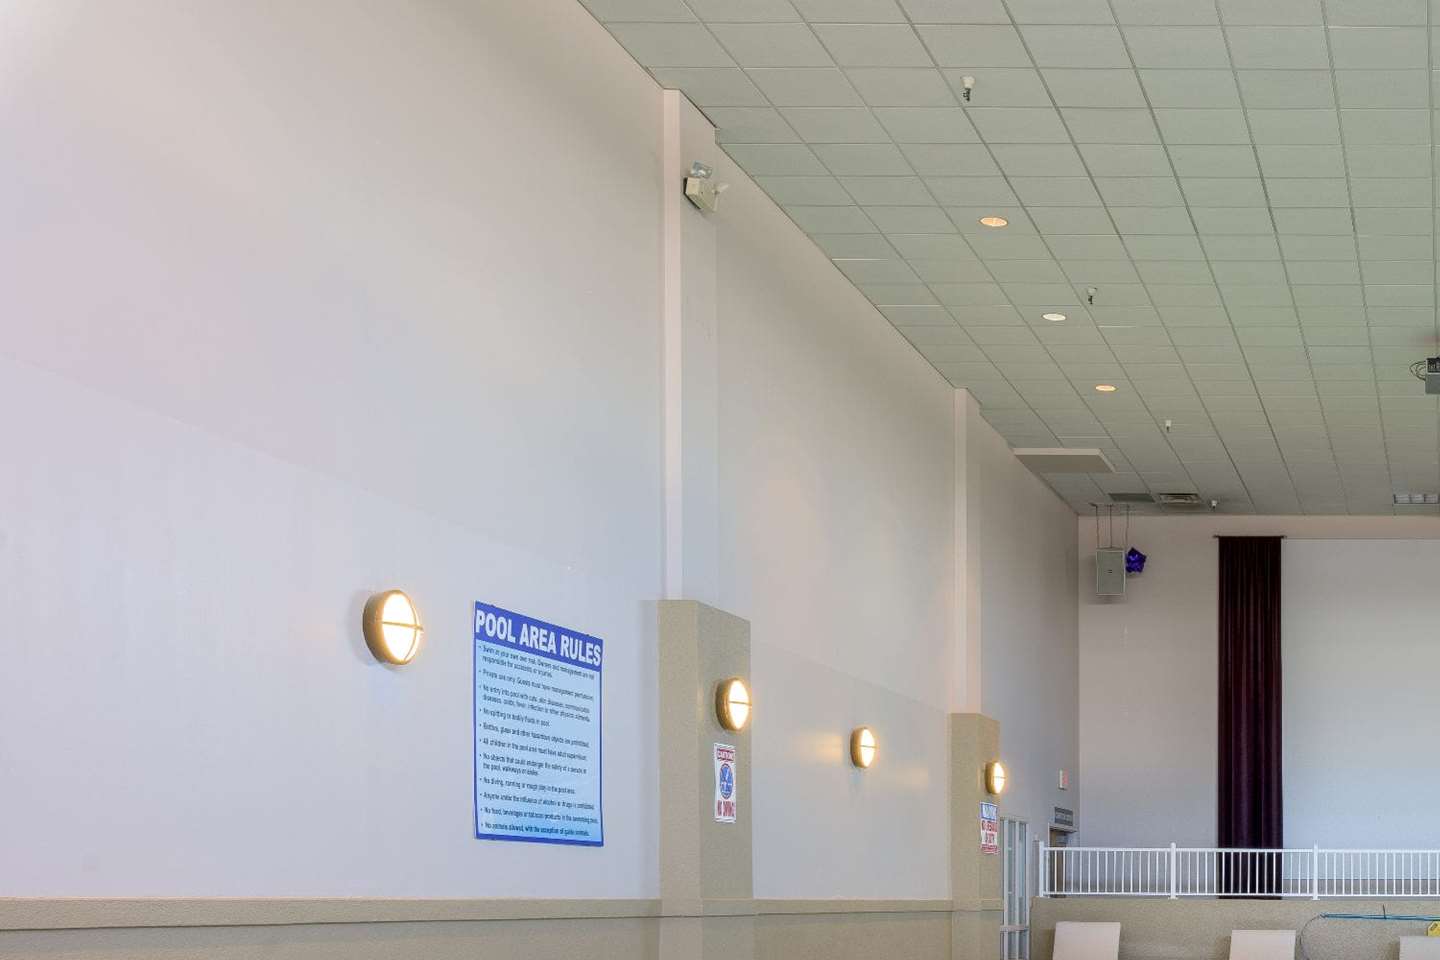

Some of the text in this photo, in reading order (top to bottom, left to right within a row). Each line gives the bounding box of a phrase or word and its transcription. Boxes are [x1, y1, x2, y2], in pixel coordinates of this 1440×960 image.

[475, 609, 516, 643] POOL
[519, 623, 557, 654] AREA
[559, 635, 601, 667] RULES
